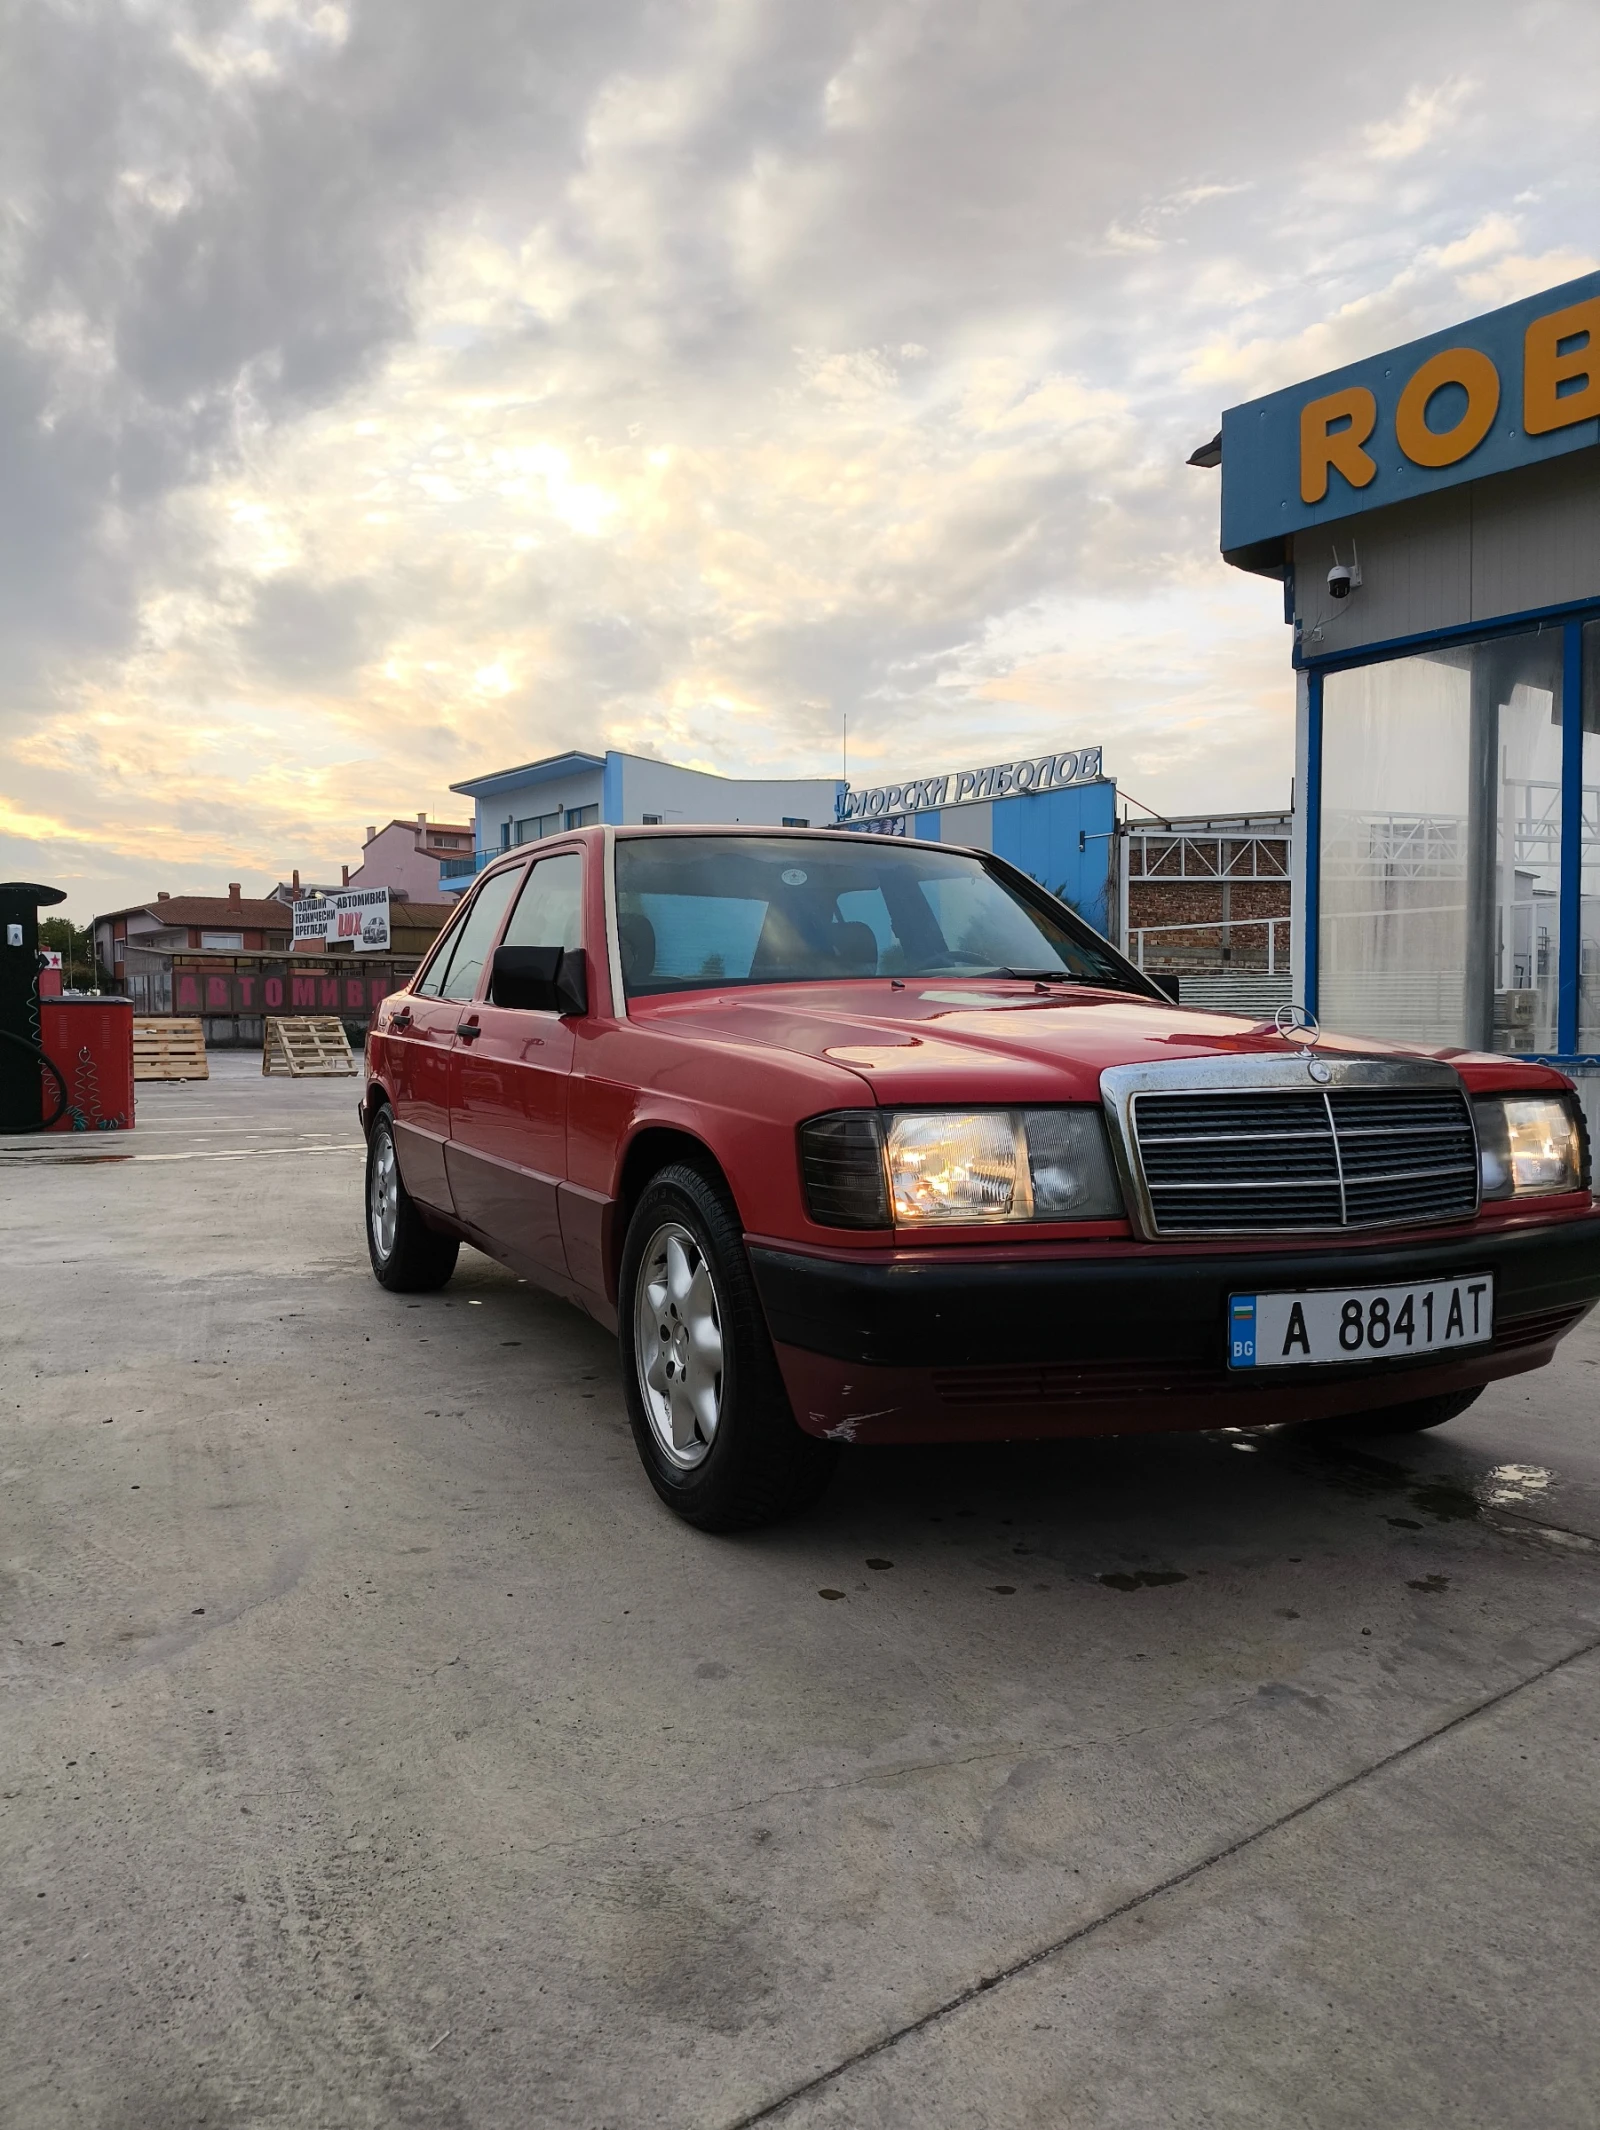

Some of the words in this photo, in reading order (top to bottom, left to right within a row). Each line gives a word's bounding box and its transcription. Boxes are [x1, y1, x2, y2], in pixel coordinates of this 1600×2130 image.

[1300, 295, 1600, 503] ROB
[847, 776, 950, 816] МОРСКИ
[954, 749, 1101, 801] РИБОЛОВ
[337, 890, 387, 909] АВТОМИВКА
[295, 909, 336, 924] ТЕХНИЧЕСКИ
[295, 922, 328, 936] ПРЕГЛЕДИ
[337, 911, 363, 937] LUX
[180, 976, 408, 1007] АВТОМИВК
[1281, 1301, 1311, 1356] A
[1233, 1341, 1253, 1357] BG
